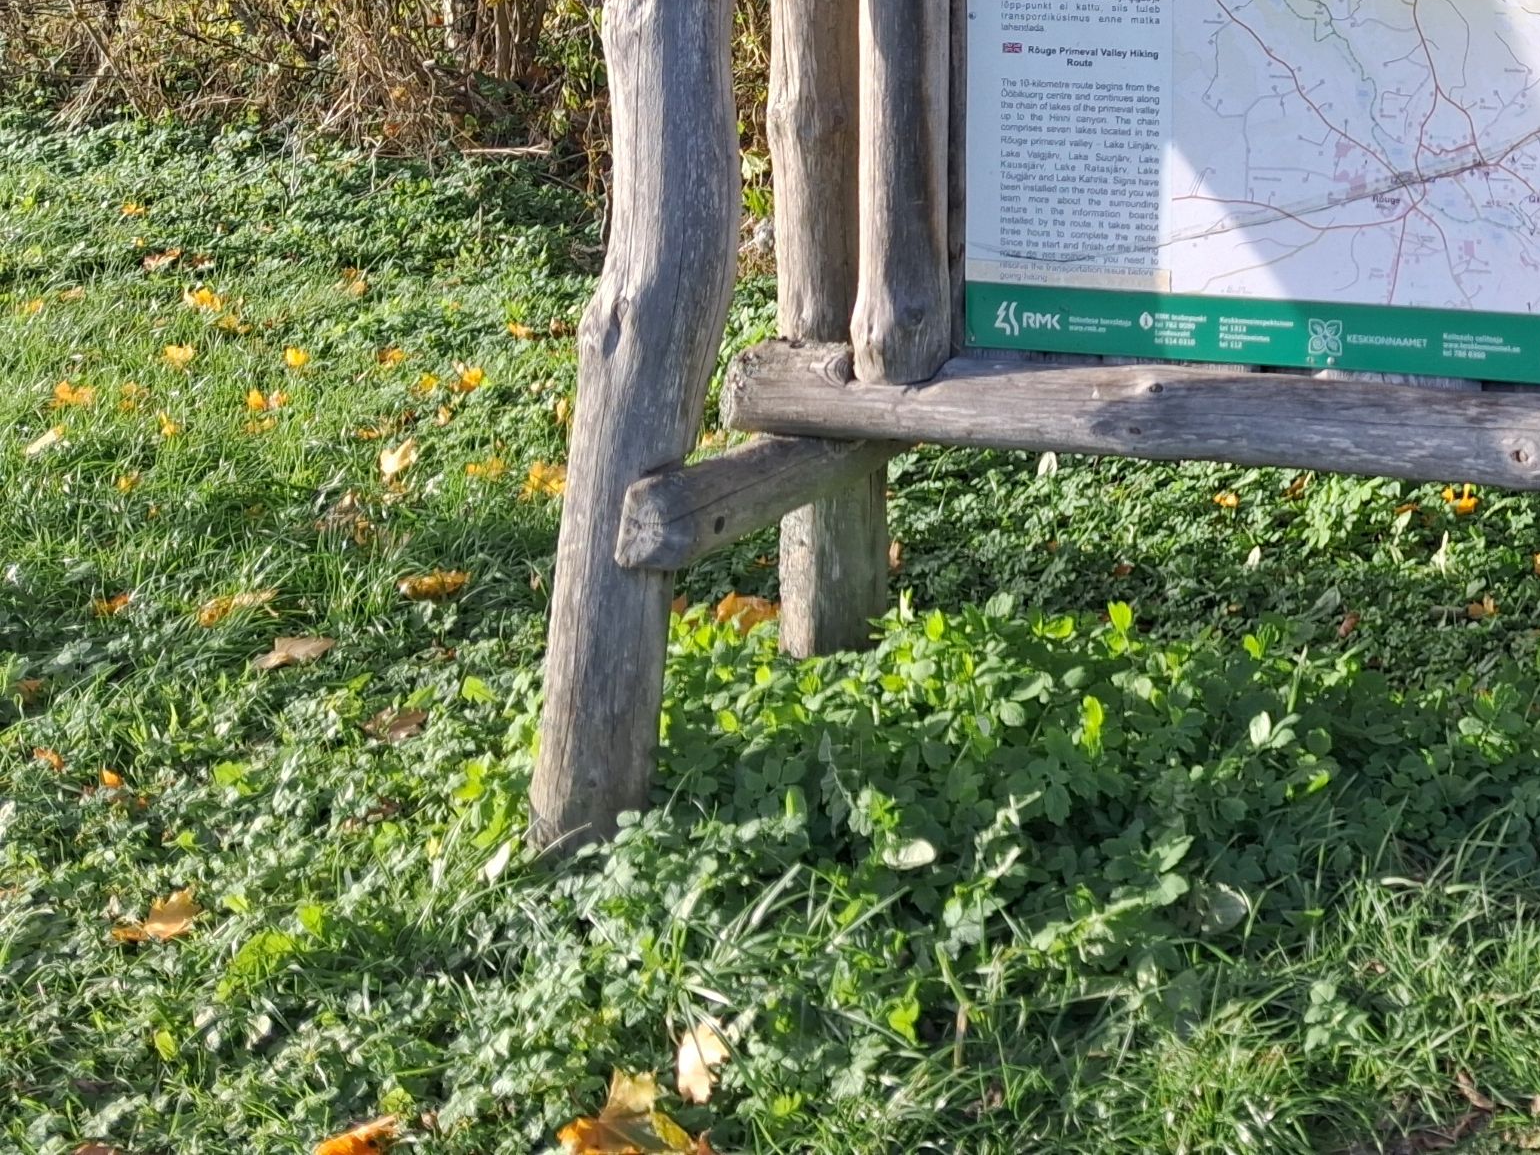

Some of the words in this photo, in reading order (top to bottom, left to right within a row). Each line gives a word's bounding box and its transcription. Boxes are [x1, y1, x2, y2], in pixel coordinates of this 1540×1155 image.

[1001, 1, 1052, 12] lõpp-punkt
[1060, 3, 1068, 11] ei
[1112, 4, 1128, 12] siis
[1136, 4, 1160, 13] tuleb
[1028, 45, 1057, 56] Rõuge
[1059, 46, 1098, 57] Primeval
[1100, 47, 1127, 59] Valley
[1129, 47, 1159, 60] Hiking
[1066, 58, 1093, 67] Route
[1003, 79, 1017, 87] The
[1072, 81, 1093, 90] route
[1096, 82, 1123, 92] begins
[1125, 83, 1145, 92] from
[1147, 84, 1160, 92] the
[1046, 91, 1072, 100] centre
[1075, 92, 1091, 101] and
[1094, 93, 1134, 102] continues
[1137, 94, 1160, 105] along
[1001, 101, 1014, 109] the
[1016, 101, 1038, 110] chain
[1040, 102, 1048, 110] of
[1049, 102, 1071, 111] lakes
[1073, 103, 1081, 112] of
[1083, 104, 1096, 112] the
[1098, 104, 1134, 115] primeval
[1135, 106, 1160, 116] valley
[1001, 113, 1011, 122] up
[1017, 113, 1025, 121] to
[1030, 113, 1043, 122] the
[1049, 114, 1071, 122] Hinni
[1116, 116, 1131, 125] The
[1137, 117, 1160, 126] chain
[1001, 124, 1043, 135] comprises
[1047, 126, 1071, 134] seven
[1075, 126, 1097, 135] lakes
[1101, 127, 1131, 136] located
[1135, 128, 1142, 136] in
[1146, 128, 1160, 137] the
[1001, 150, 1020, 159] Lake
[1069, 152, 1089, 161] Lake
[1139, 155, 1160, 164] Lake
[1000, 194, 1021, 203] learn
[1057, 196, 1081, 205] about
[1088, 198, 1101, 206] the
[1109, 199, 1160, 210] surrounding
[1000, 205, 1027, 214] nature
[1035, 207, 1043, 215] in
[1050, 207, 1064, 216] the
[1072, 208, 1121, 218] information
[1129, 210, 1160, 220] boards
[1022, 311, 1061, 330] RMK
[1347, 334, 1428, 348] KESKKONNAAMET
